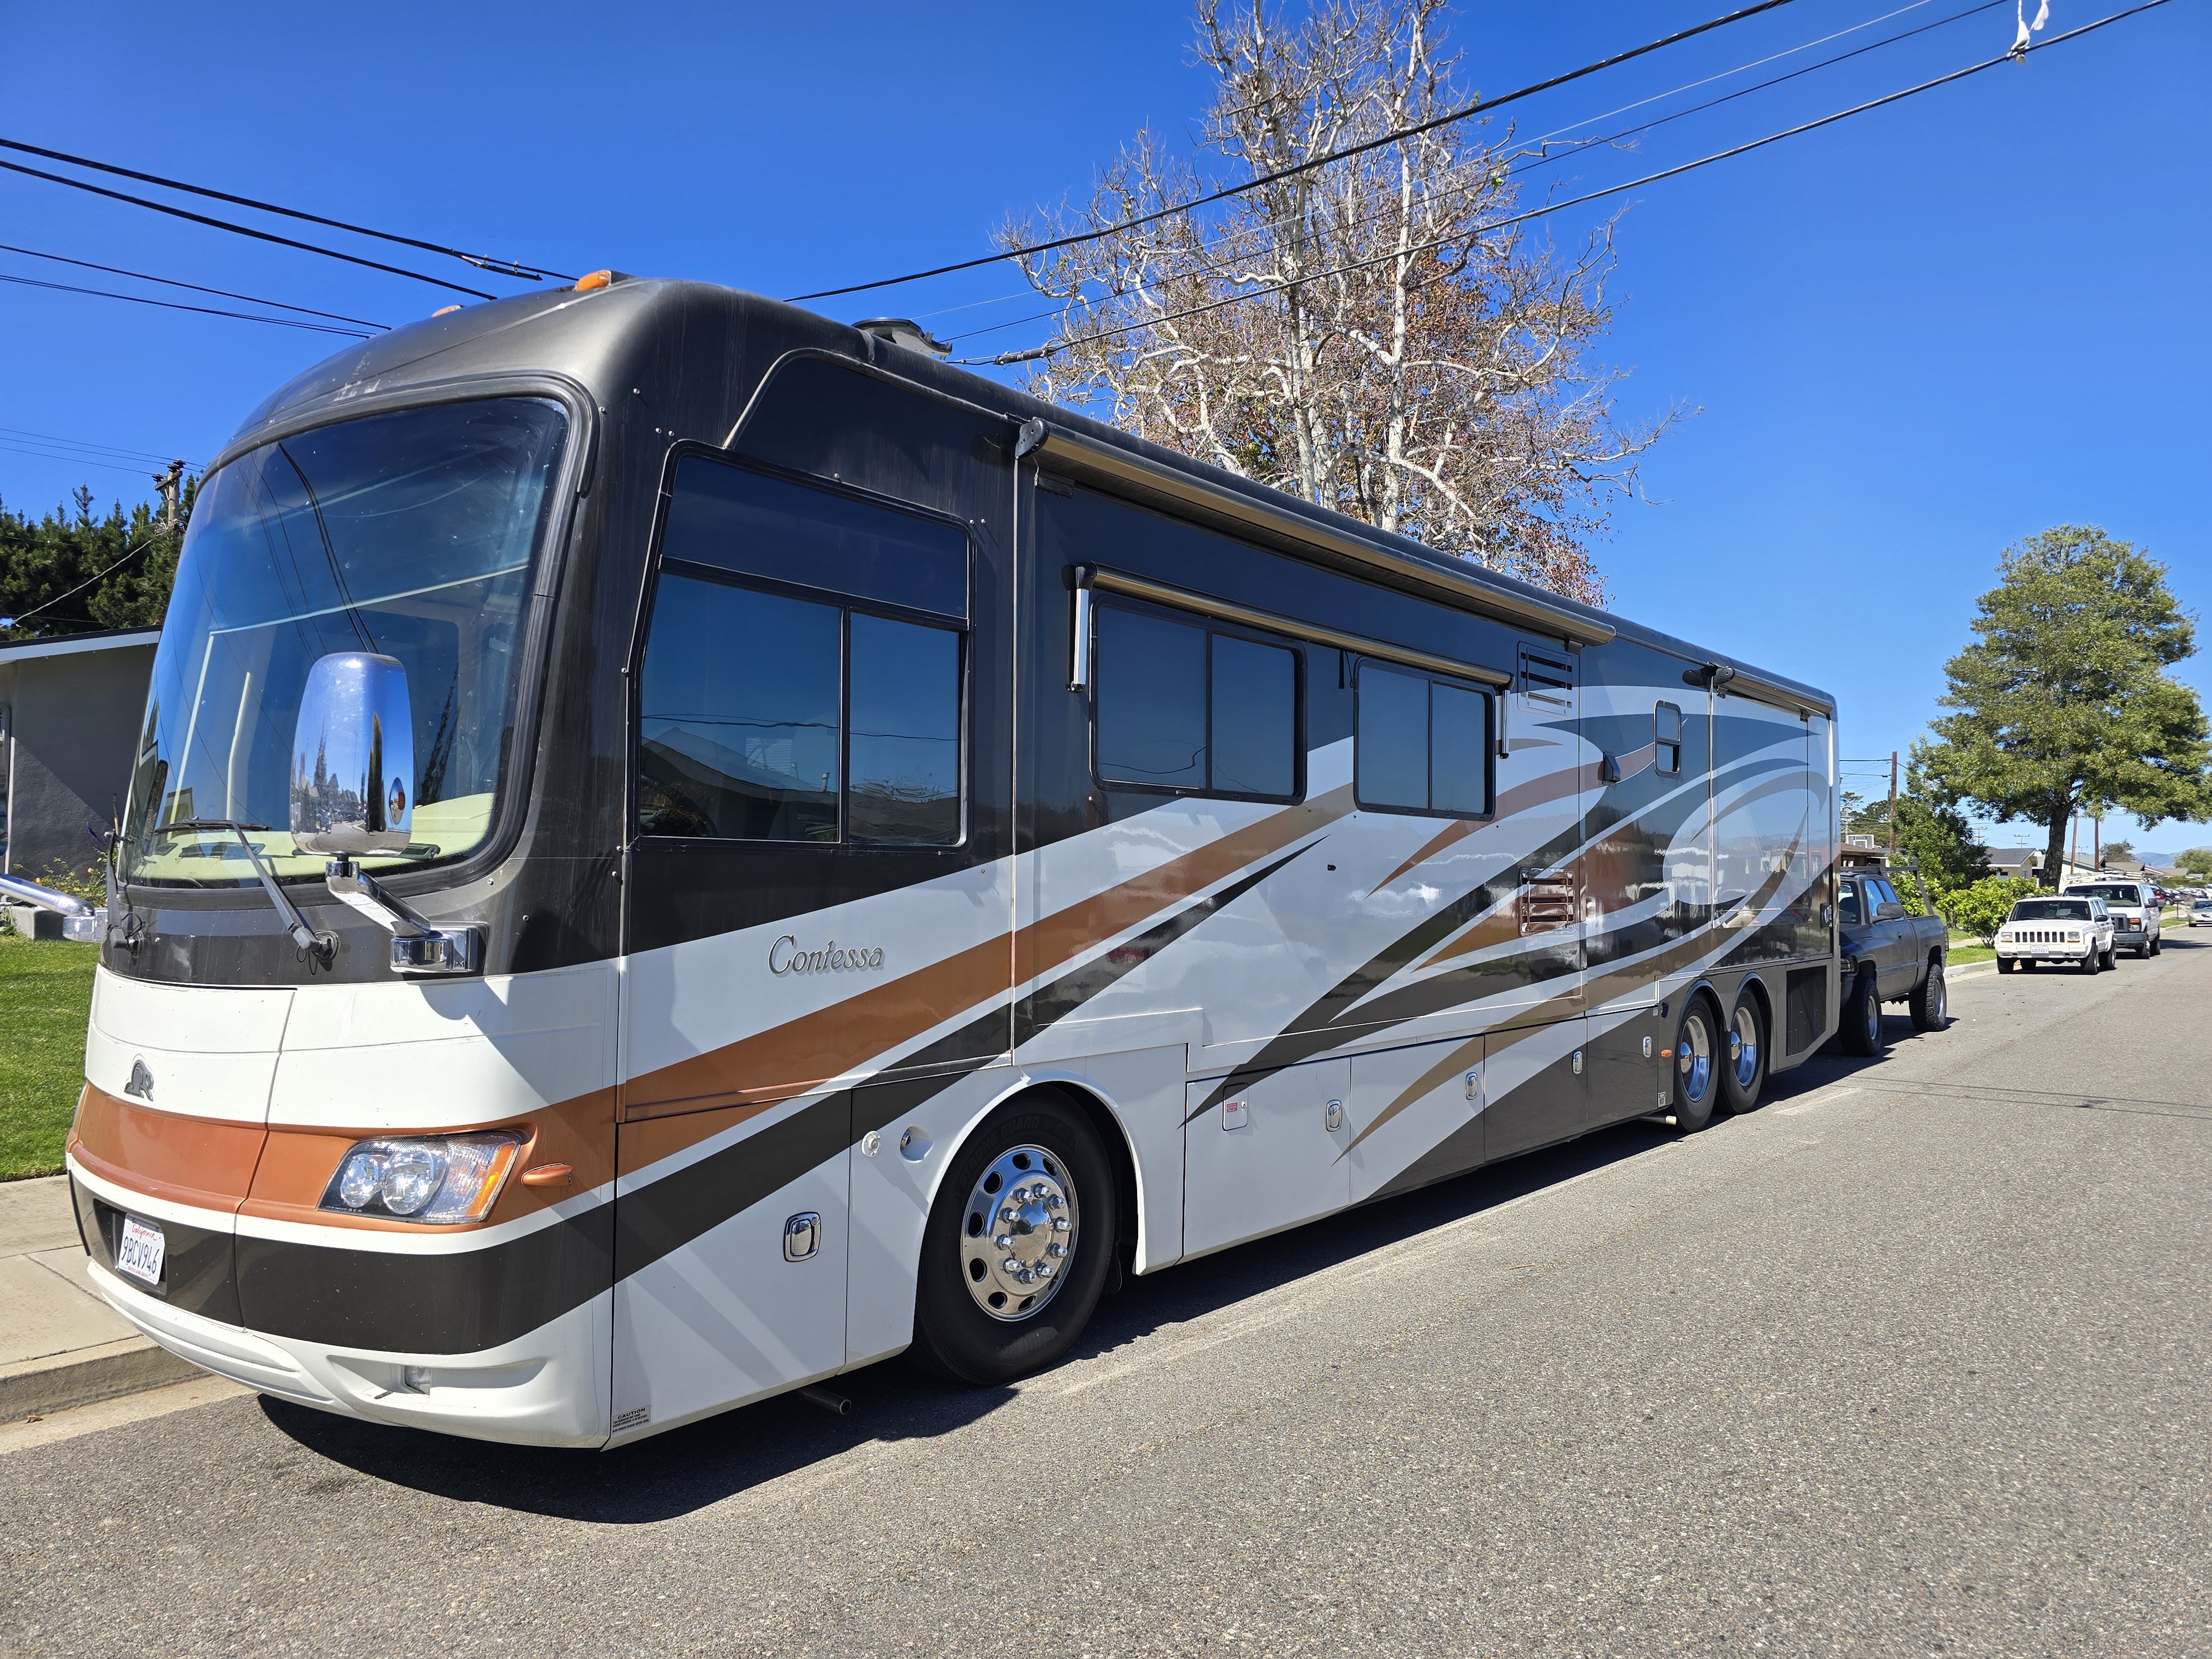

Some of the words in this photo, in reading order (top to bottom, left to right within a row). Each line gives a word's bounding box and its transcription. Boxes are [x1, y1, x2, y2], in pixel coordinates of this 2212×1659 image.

[768, 933, 883, 974] Contessa
[958, 1130, 999, 1187] STRONG
[1000, 1115, 1041, 1139] GUARD
[121, 1236, 159, 1274] 9BCV946
[618, 1407, 645, 1420] CAUTION
